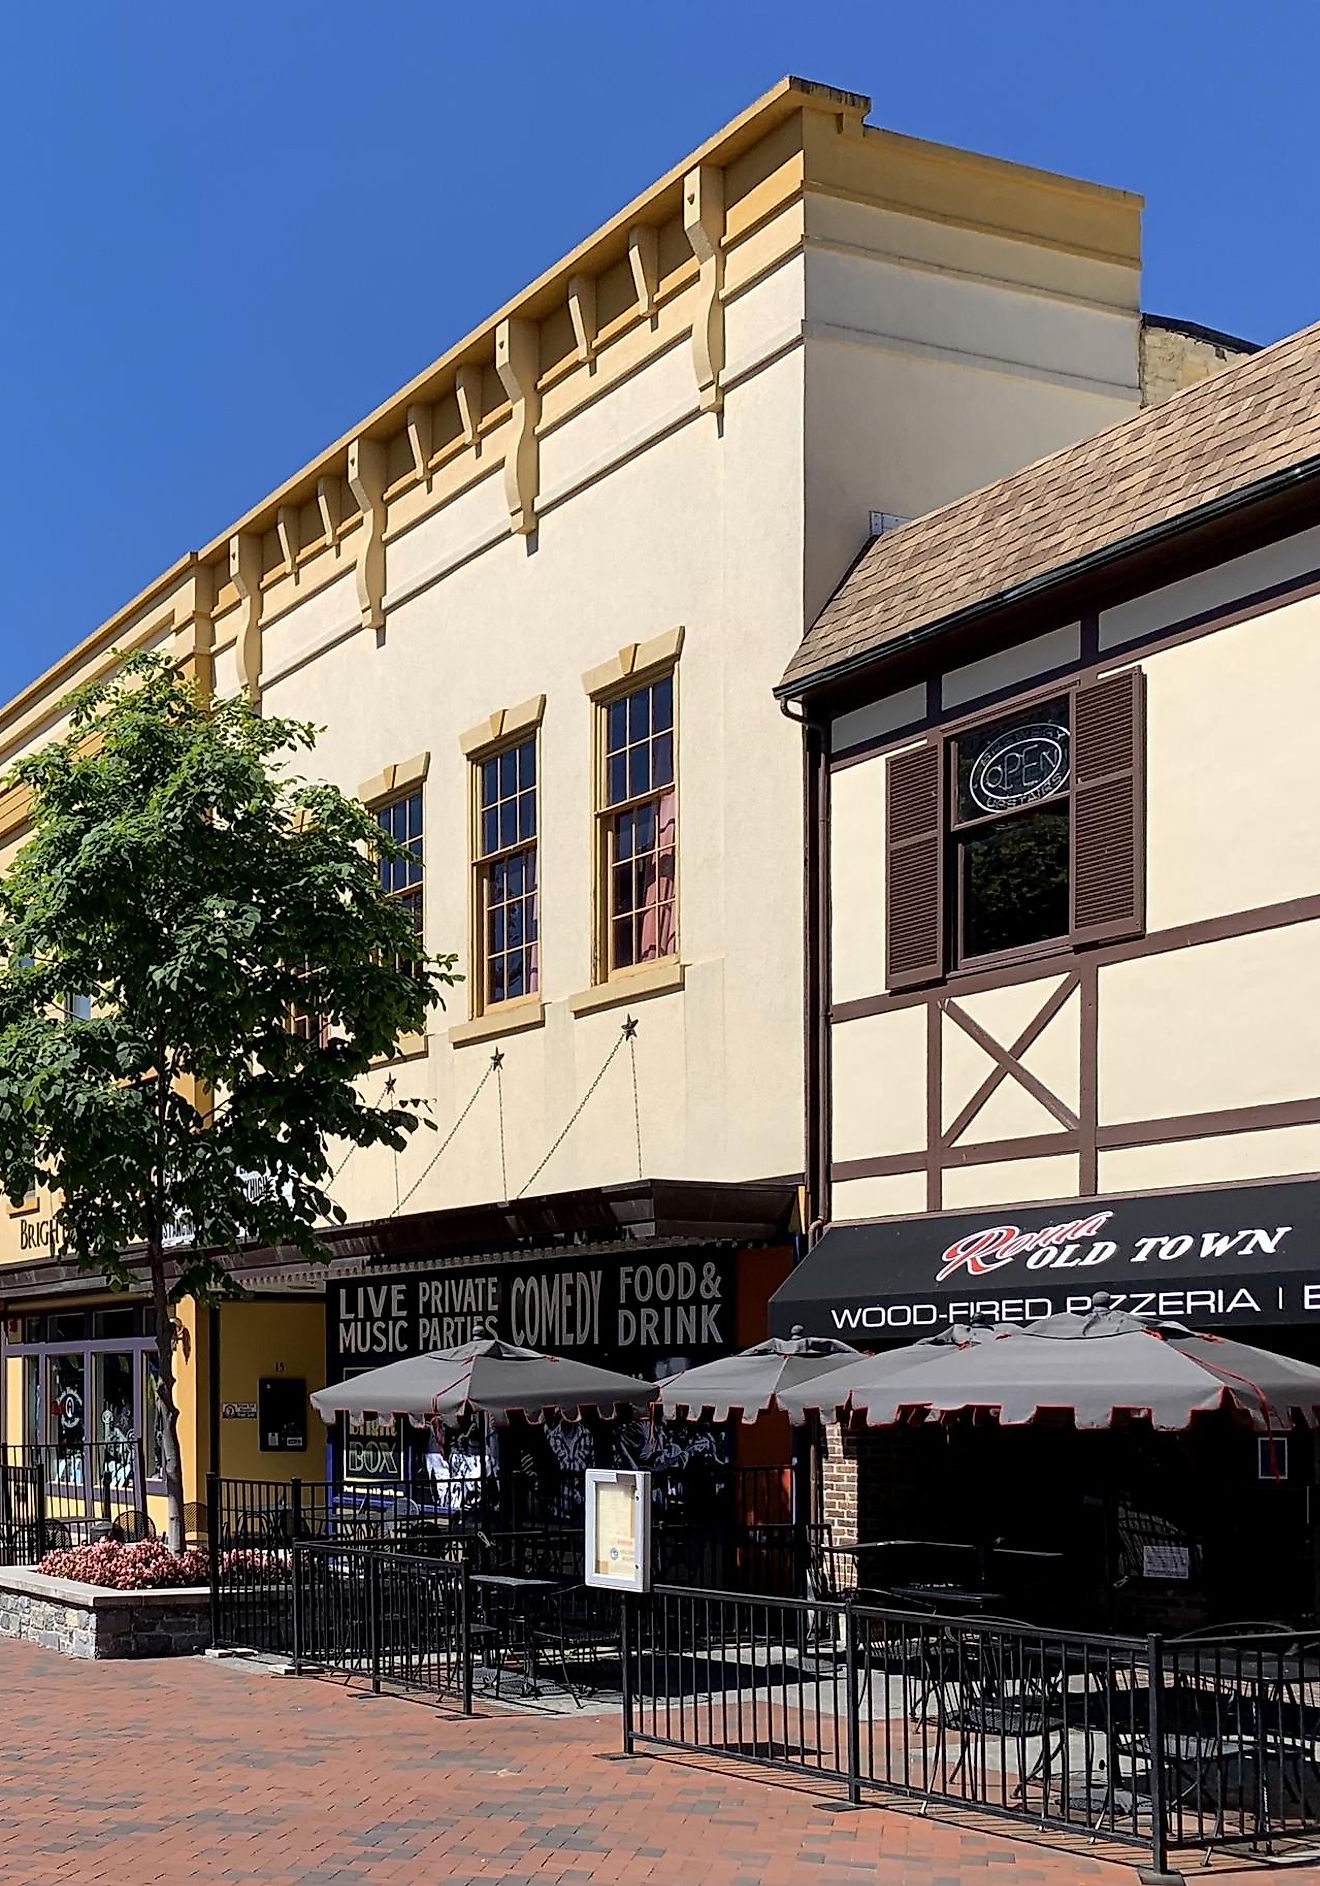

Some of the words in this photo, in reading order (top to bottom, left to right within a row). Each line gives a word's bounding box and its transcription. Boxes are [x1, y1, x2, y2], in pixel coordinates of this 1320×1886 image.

[986, 744, 1058, 791] OPEN
[936, 1210, 1114, 1282] Roma
[1026, 1241, 1117, 1271] OLD
[1131, 1226, 1293, 1263] TOWN
[338, 1284, 408, 1320] LIVE
[419, 1276, 499, 1314] PRIVATE
[510, 1270, 604, 1347] COMEDY
[831, 1297, 1052, 1330] WOOD-FIRED
[1066, 1288, 1261, 1316] PZZERIA
[338, 1319, 409, 1354] MUSIC
[618, 1304, 724, 1347] DRINK
[348, 1441, 398, 1473] BOX
